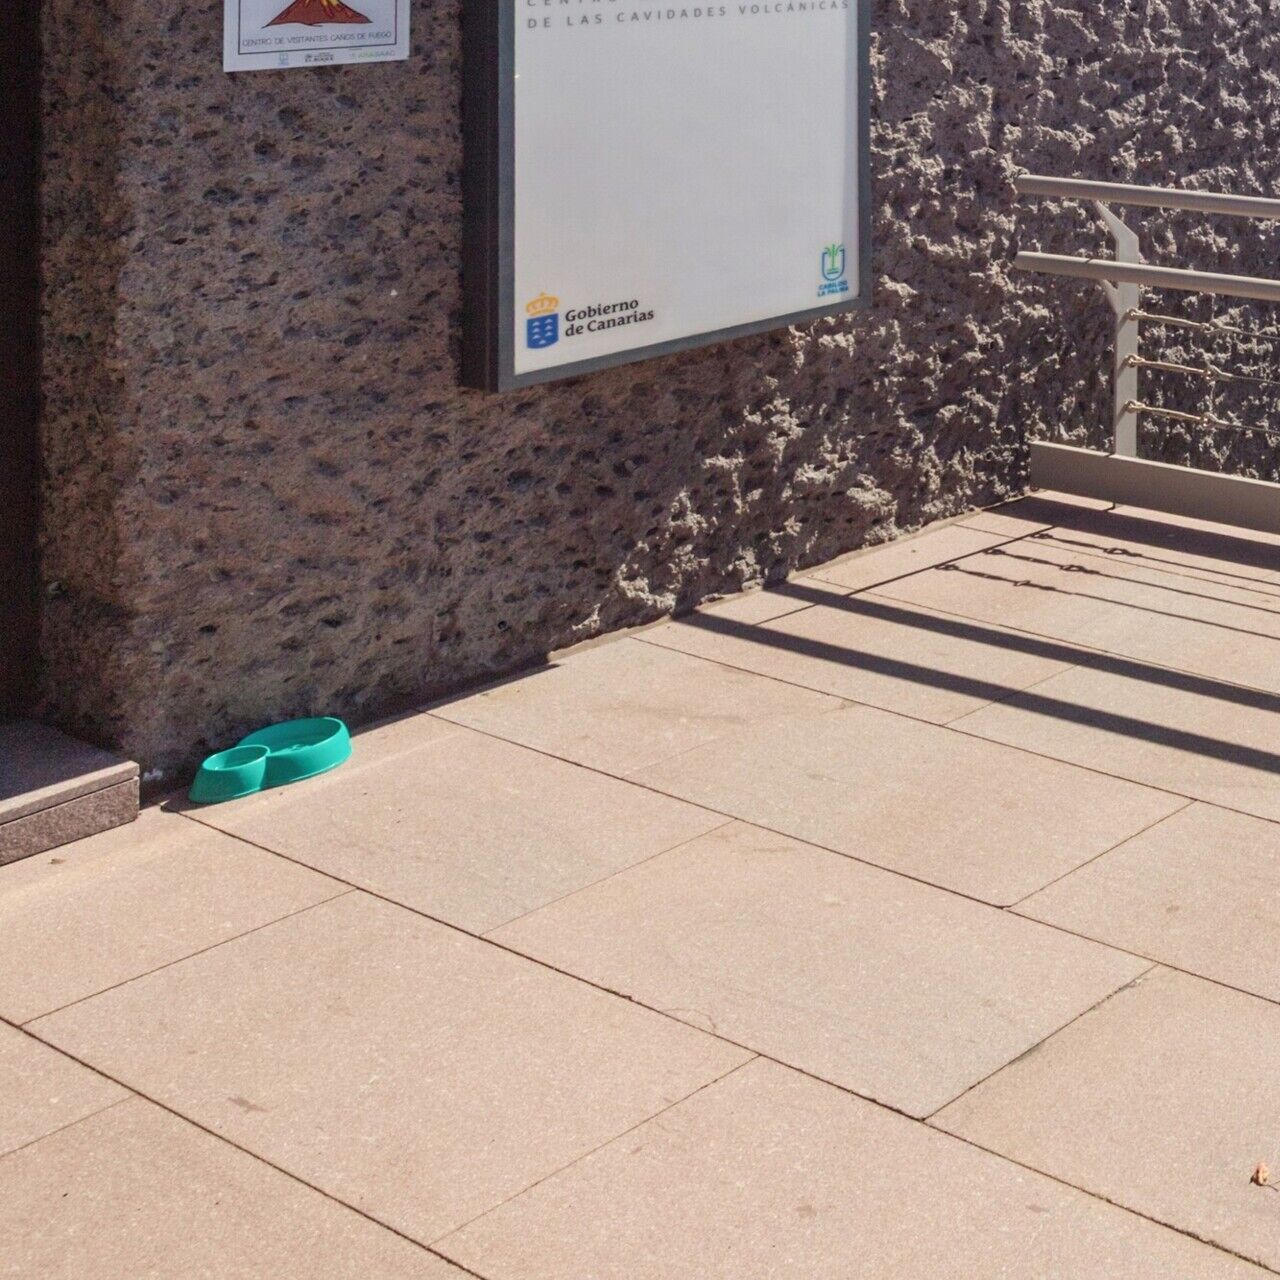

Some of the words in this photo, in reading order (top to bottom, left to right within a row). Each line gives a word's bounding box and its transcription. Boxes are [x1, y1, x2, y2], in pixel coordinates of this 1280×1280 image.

[527, 18, 552, 30] DE
[566, 14, 603, 27] LAS
[617, 6, 727, 23] CAVIDADES
[738, 0, 849, 16] VOLCÁNICAS
[242, 38, 272, 46] CENTRO
[274, 37, 285, 45] DE
[356, 31, 367, 40] DE
[565, 299, 639, 322] Gobierno
[565, 324, 584, 337] de
[587, 310, 654, 332] Canarias
